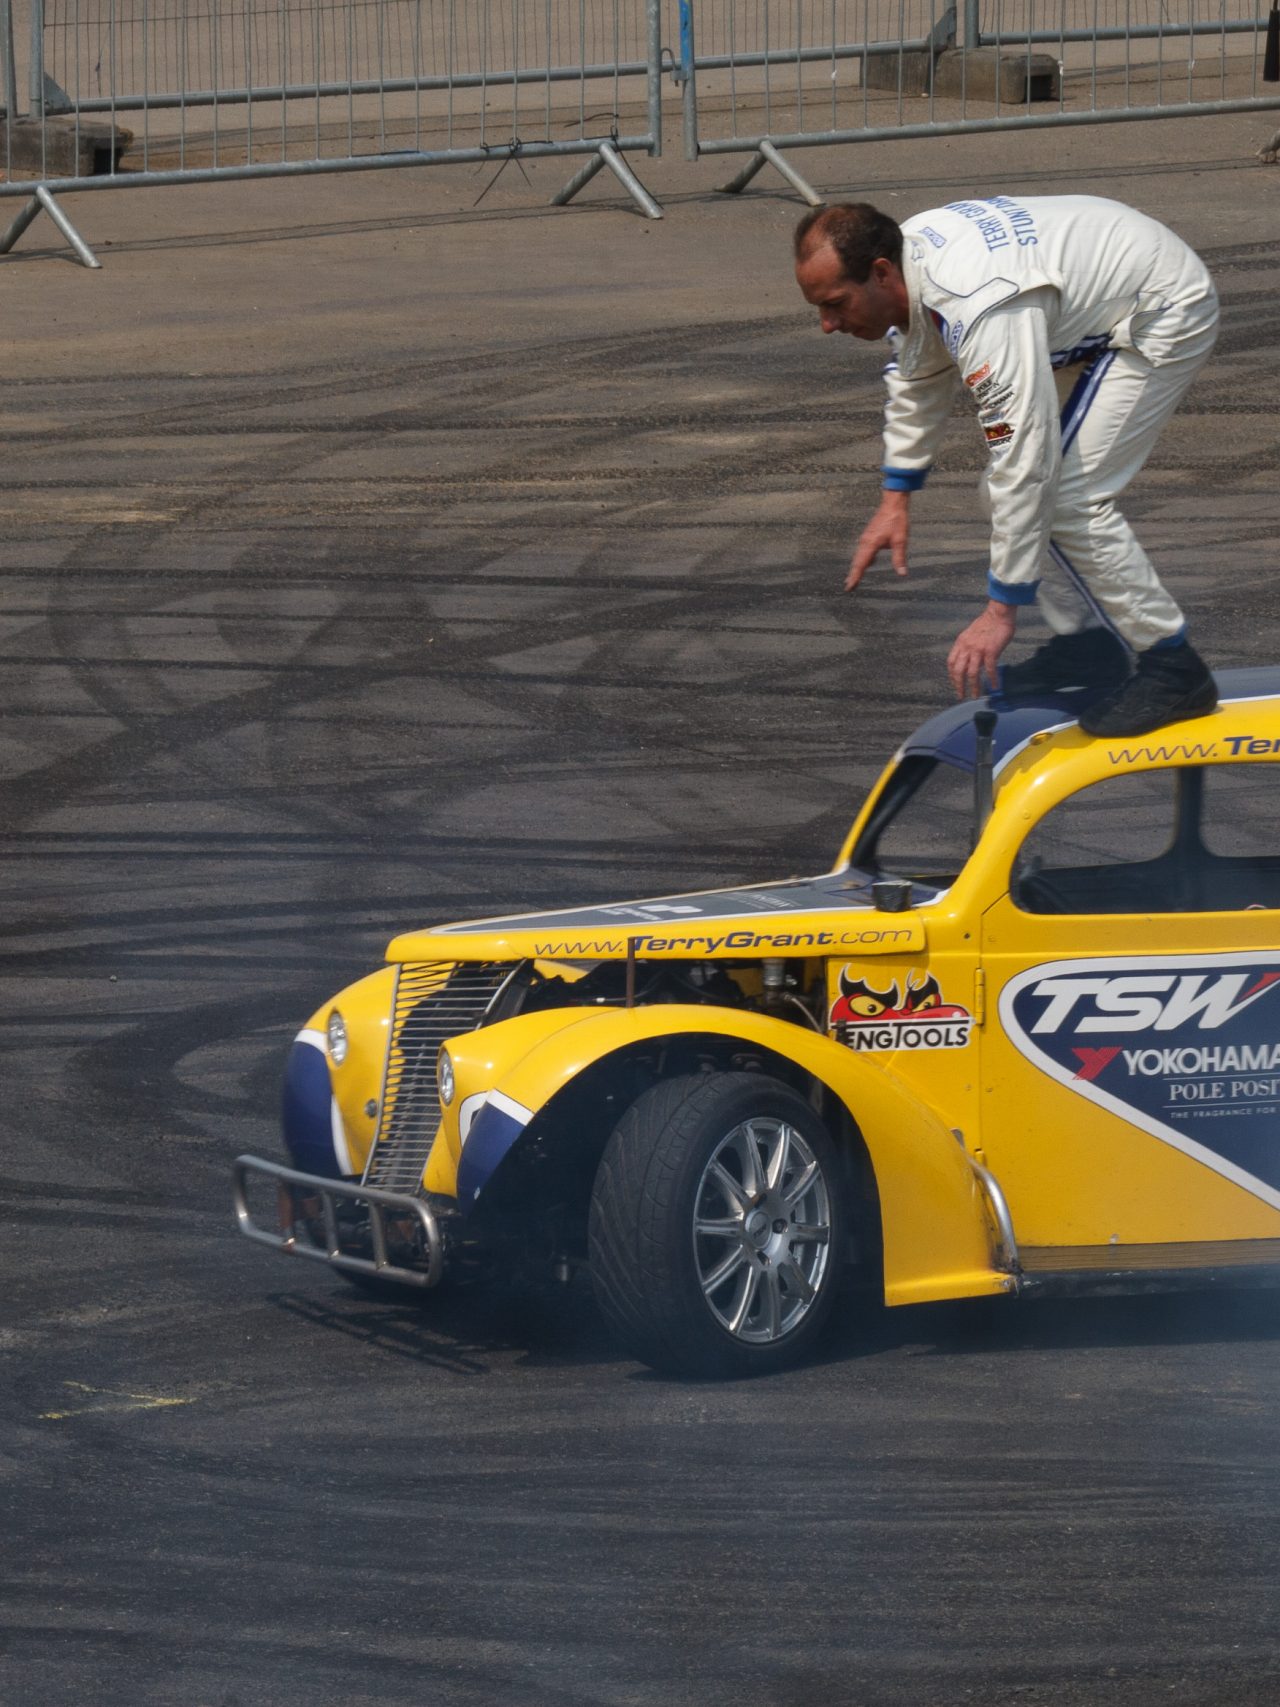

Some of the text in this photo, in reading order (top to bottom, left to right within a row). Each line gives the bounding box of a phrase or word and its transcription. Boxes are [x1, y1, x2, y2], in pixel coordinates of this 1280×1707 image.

[973, 215, 1010, 252] TERRY
[1001, 207, 1039, 246] STUNT
[534, 929, 912, 955] www.TerryGrant.com
[1169, 1082, 1225, 1101] POLE
[1170, 1111, 1189, 1119] THE
[1193, 1107, 1252, 1118] FRAGRANCE
[1256, 1106, 1276, 1114] FOR
